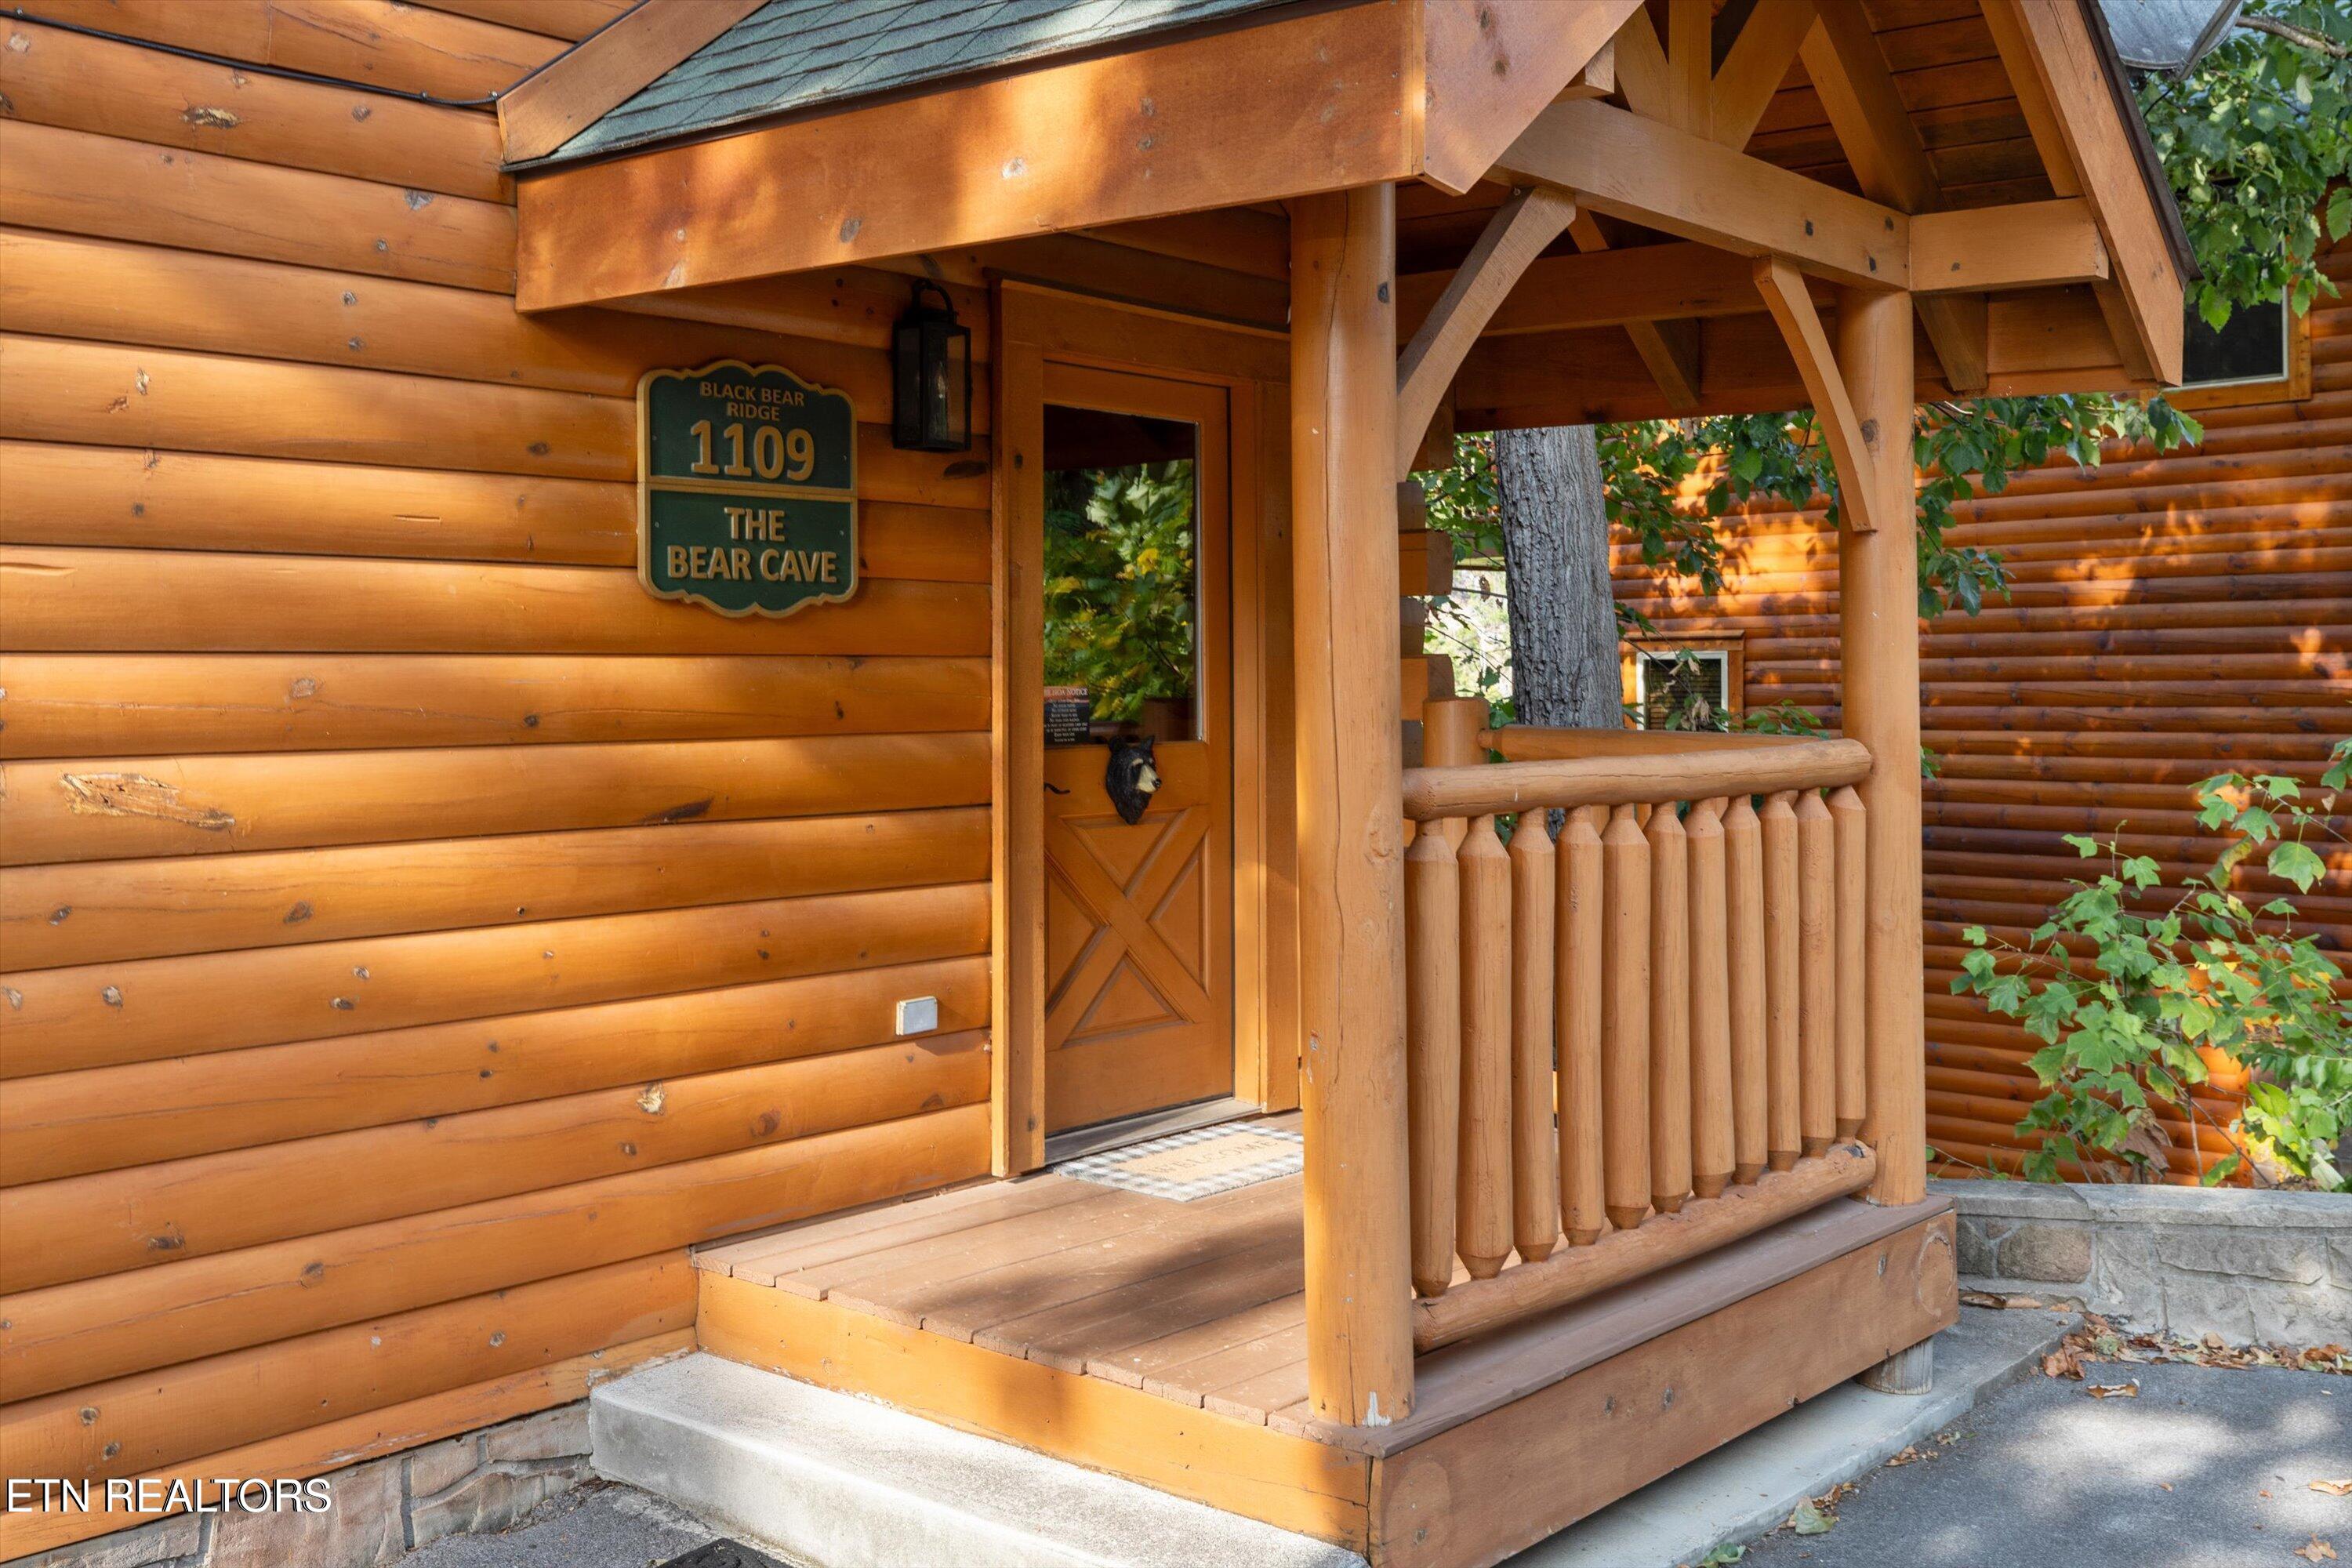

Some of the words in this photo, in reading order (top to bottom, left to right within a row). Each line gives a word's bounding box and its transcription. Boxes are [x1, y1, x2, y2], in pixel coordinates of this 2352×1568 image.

[699, 381, 757, 401] BLACK
[760, 387, 805, 406] BEAR
[726, 401, 781, 421] RIDGE
[690, 419, 815, 481] 1109
[724, 506, 786, 543] THE
[666, 545, 752, 581] BEAR
[760, 548, 837, 583] CAVE
